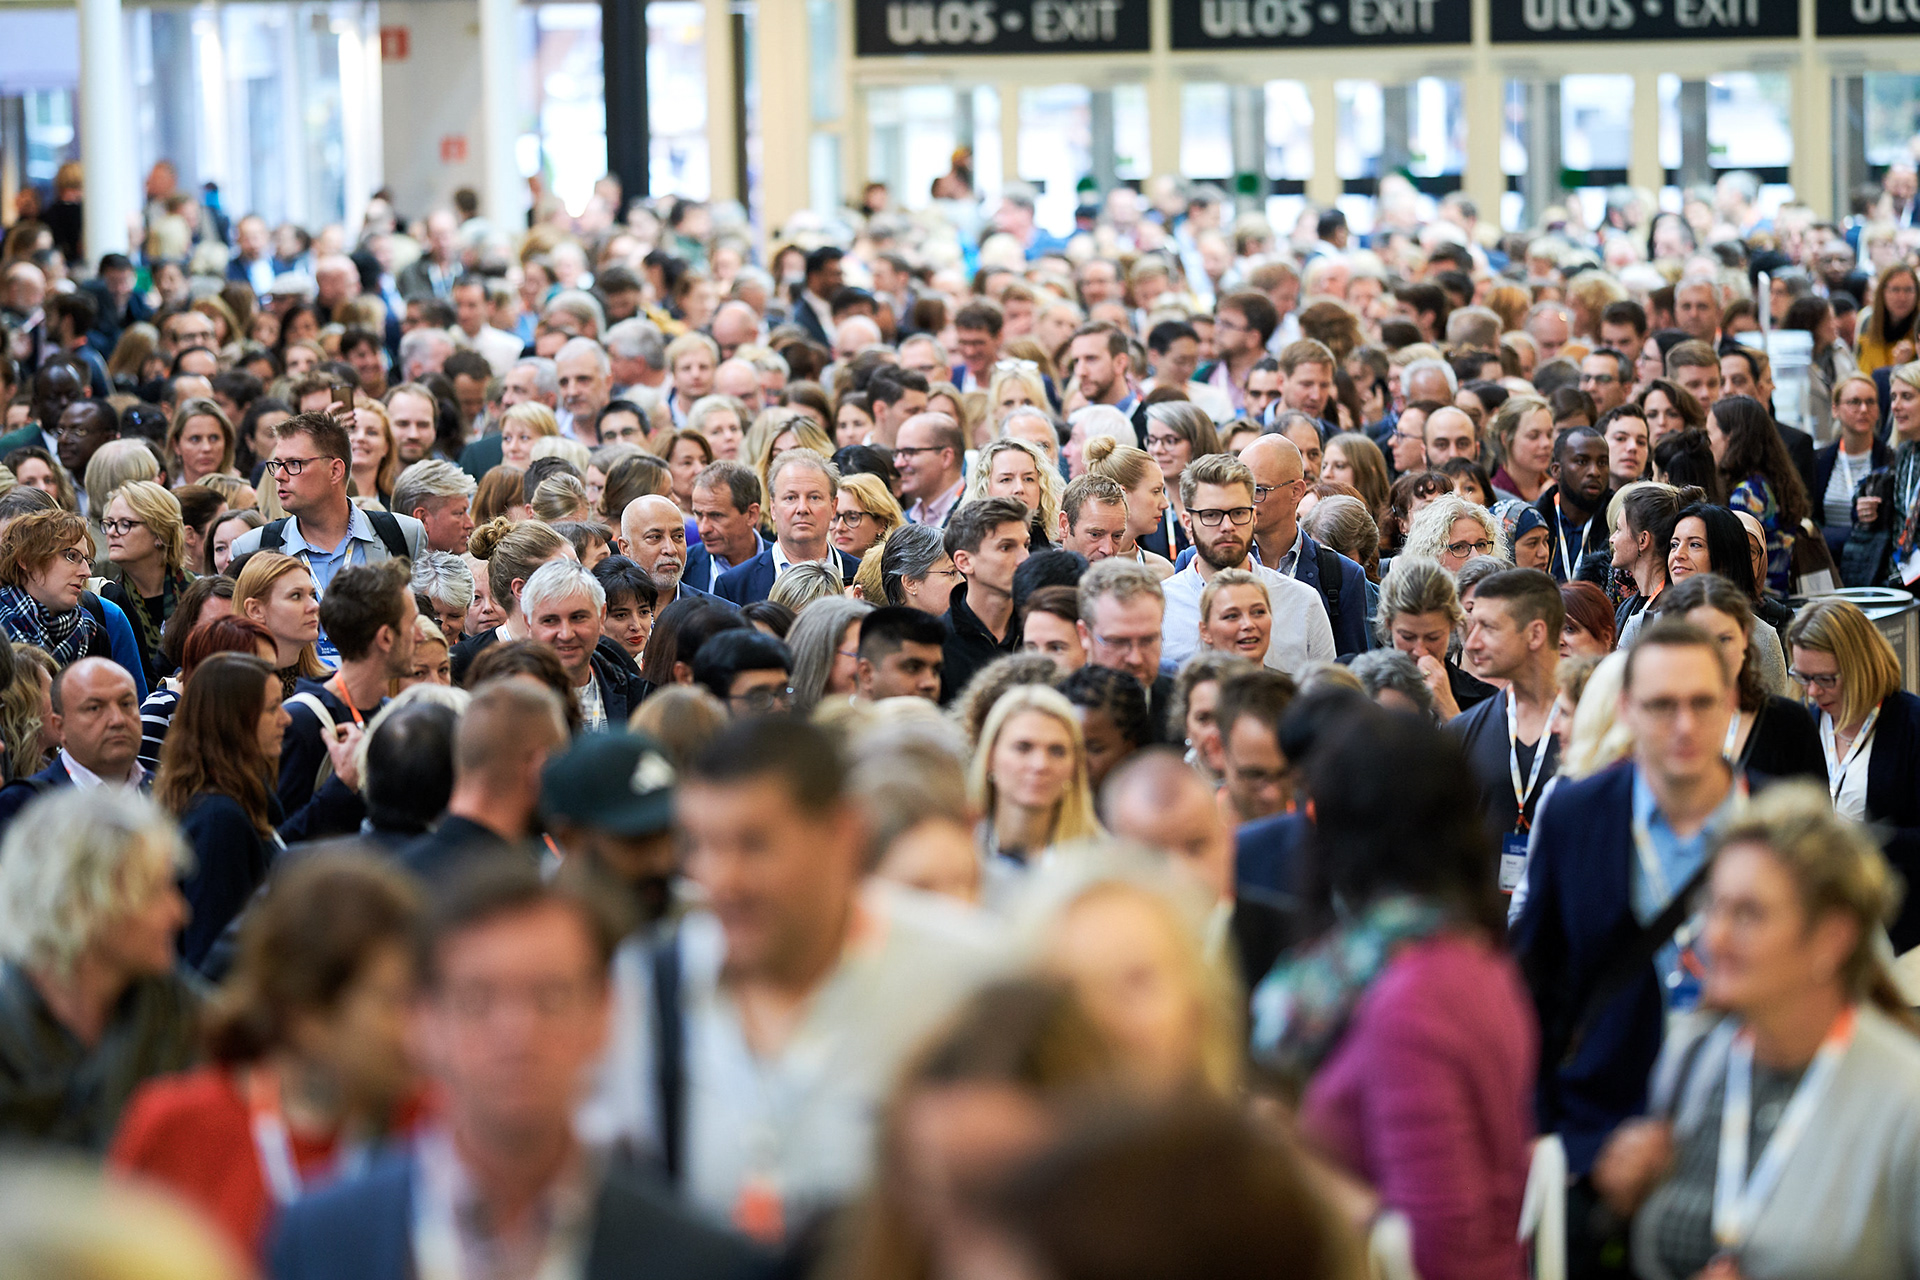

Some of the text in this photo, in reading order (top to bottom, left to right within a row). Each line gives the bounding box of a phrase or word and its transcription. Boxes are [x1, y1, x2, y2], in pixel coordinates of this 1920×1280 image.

[886, 1, 996, 44] ULOS
[1031, 0, 1120, 43] EXIT
[1201, 0, 1312, 38] ULOS
[1349, 0, 1437, 35] EXIT
[1522, 0, 1634, 31] ULOS
